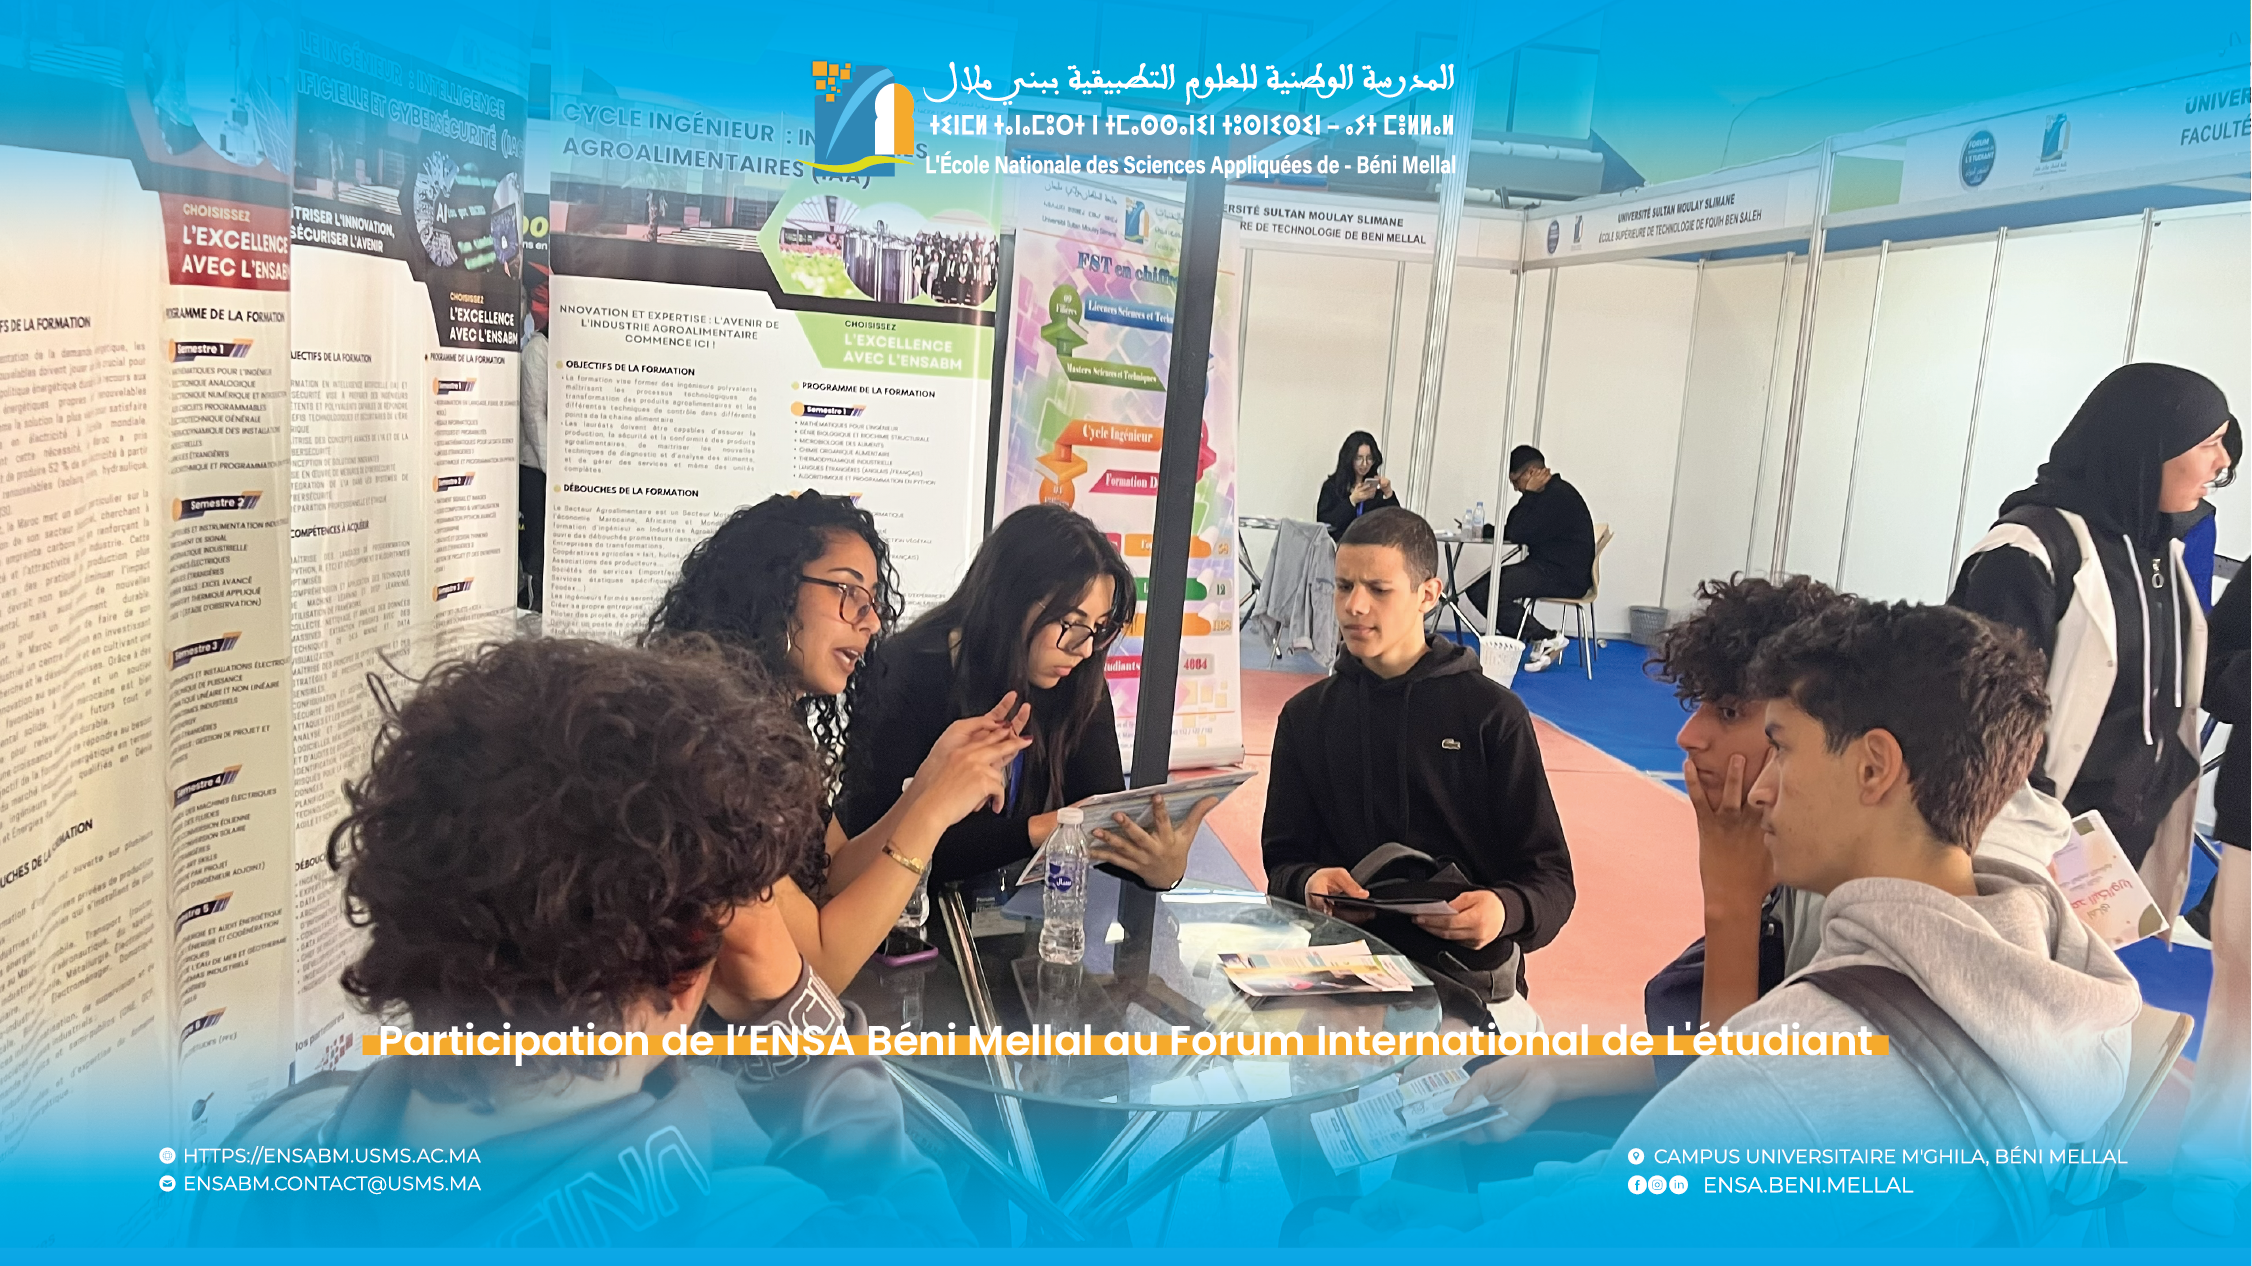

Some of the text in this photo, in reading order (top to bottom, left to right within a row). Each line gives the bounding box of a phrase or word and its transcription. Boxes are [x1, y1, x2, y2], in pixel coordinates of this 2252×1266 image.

[322, 35, 402, 86] INGÉNIEUR
[417, 69, 505, 121] INTELLIGENCE
[371, 91, 386, 118] ET
[388, 98, 496, 151] CYBERSÉCURITÉ
[563, 103, 774, 142] CYCLE INGÉNIEUR
[563, 137, 803, 177] AGROALIMENTAIRES
[183, 203, 250, 222] CHOISISSEZ
[1263, 207, 1306, 220] SULTAN
[1308, 210, 1354, 224] MOULAY
[1356, 214, 1404, 228] SLIMANE
[1618, 194, 1735, 223] UNIVERSITÉ SULTAN MOULAY SLIMANE
[335, 214, 395, 239] L'INNOVATION,
[1255, 222, 1269, 233] DE
[1272, 223, 1342, 239] TECHNOLOGIE
[1344, 230, 1359, 241] DE
[1361, 231, 1384, 242] BENI
[1386, 233, 1427, 245] MELLAL
[1599, 209, 1762, 243] ÉCOLE SUPÉRIEURE DE TECHNOLOGIE DE FQUIH BEN SALEH
[183, 225, 288, 254] L'EXCELLENCE
[291, 225, 383, 253] SÉCURISER L'AVENIR
[535, 241, 548, 251] en
[182, 254, 289, 280] AVEC L'ENSAB
[1077, 251, 1112, 275] FST
[1115, 264, 1132, 279] en
[450, 292, 484, 305] CHOISISSEZ
[11, 316, 91, 332] DE LA FORMATION
[210, 308, 285, 322] DE LA FORMATION
[450, 307, 514, 327] L'EXCELLENCE
[560, 304, 779, 329] NNOVATION ET EXPERTISE L'AVENIR DE
[1146, 311, 1153, 320] et
[581, 319, 758, 340] L'INDUSTRIE AGROALIMENTAIRE
[845, 320, 897, 331] CHOISISSEZ
[450, 327, 518, 345] AVEC L'ENSABM
[625, 334, 710, 349] COMMENCE ICI
[845, 334, 952, 353] L'EXCELLENCE
[220, 345, 224, 353] 1
[324, 353, 332, 362] DE
[333, 353, 341, 362] LA
[342, 354, 372, 363] FORMATION
[458, 354, 464, 362] DE
[466, 355, 474, 363] LA
[475, 356, 505, 364] FORMATION
[566, 360, 695, 376] OBJECTIFS DE LA FORMATION
[843, 351, 962, 371] AVEC L'ENSABM
[1067, 363, 1091, 374] Masters
[1118, 371, 1123, 379] et
[1124, 371, 1156, 384] Techniques
[803, 382, 935, 398] PROGRAMME DE LA FORMATION
[807, 406, 842, 415] Semestre
[1083, 423, 1153, 443] Cycle Ingénieur
[564, 482, 617, 494] DÉBOUCHES
[619, 487, 630, 495] DE
[645, 488, 699, 497] FORMATION
[1106, 473, 1147, 488] Formation
[191, 499, 235, 510] Semestre
